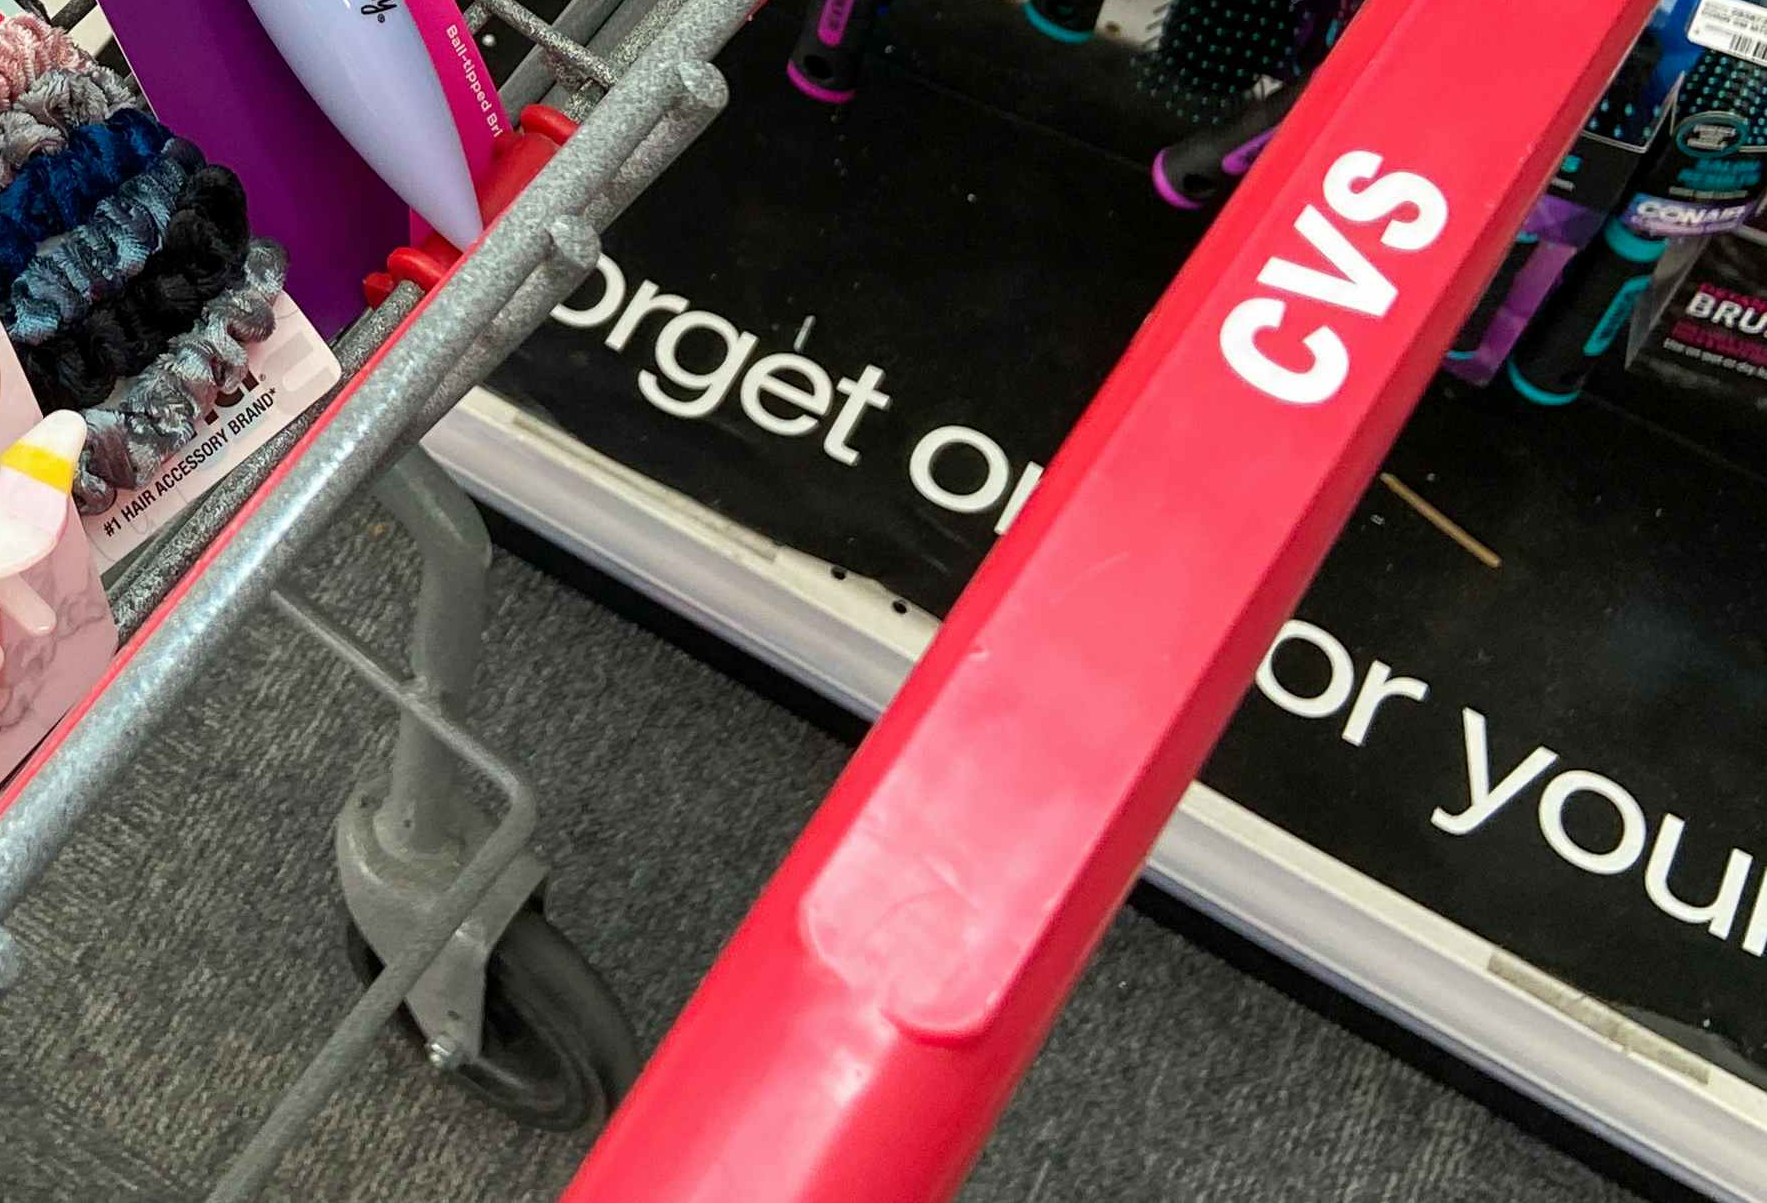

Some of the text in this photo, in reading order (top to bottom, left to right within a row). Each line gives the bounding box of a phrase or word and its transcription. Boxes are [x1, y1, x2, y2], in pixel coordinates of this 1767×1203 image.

[445, 24, 488, 114] Ball-tipped
[1219, 149, 1449, 406] CVS
[1685, 291, 1767, 335] BRU
[548, 247, 890, 466] orget
[102, 517, 121, 537] #1
[118, 489, 157, 530] HAIR
[153, 427, 229, 500] ACCESSORY
[1253, 617, 1430, 748] or
